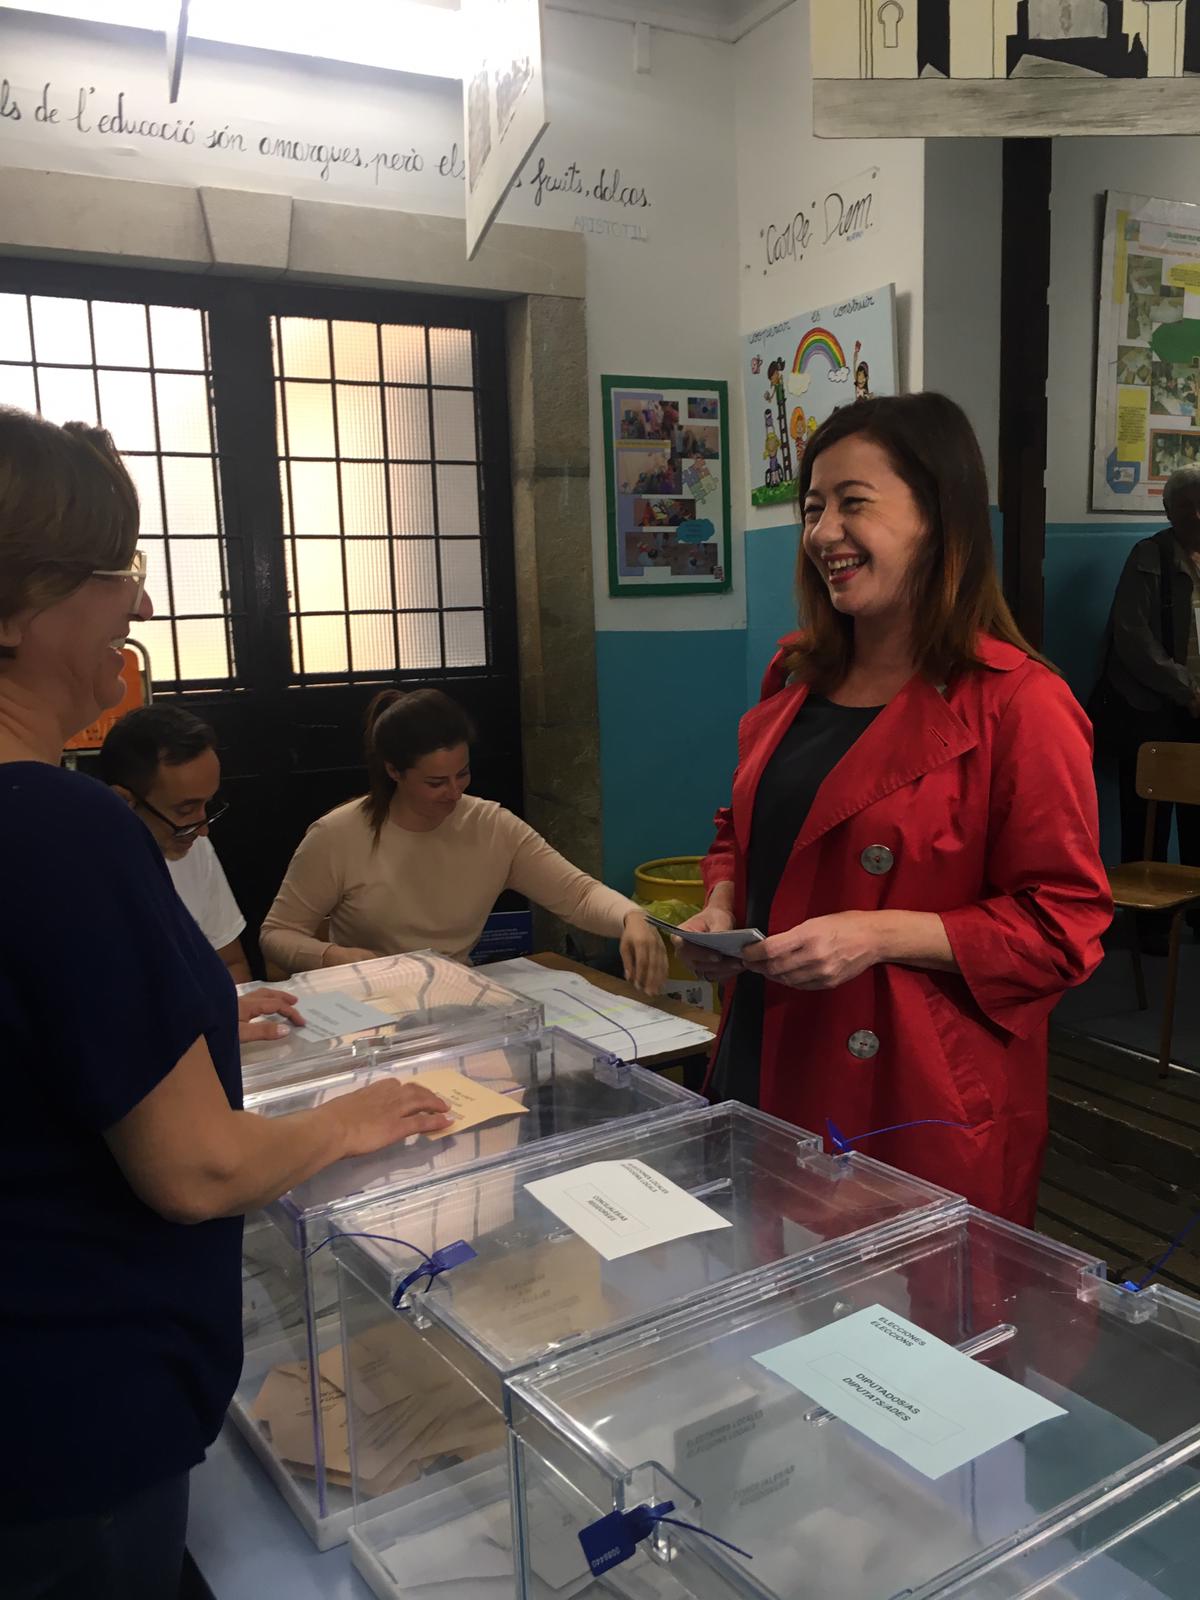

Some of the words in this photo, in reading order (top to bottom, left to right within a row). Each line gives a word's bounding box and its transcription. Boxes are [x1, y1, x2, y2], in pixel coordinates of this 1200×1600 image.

[35, 82, 60, 124] de
[204, 125, 248, 152] són
[869, 1320, 914, 1347] ELECCIONS
[878, 1316, 926, 1347] ELECCIONES
[842, 1377, 911, 1422] DIPUTATS/ADES
[855, 1372, 921, 1415] DIPUTADOS/AS
